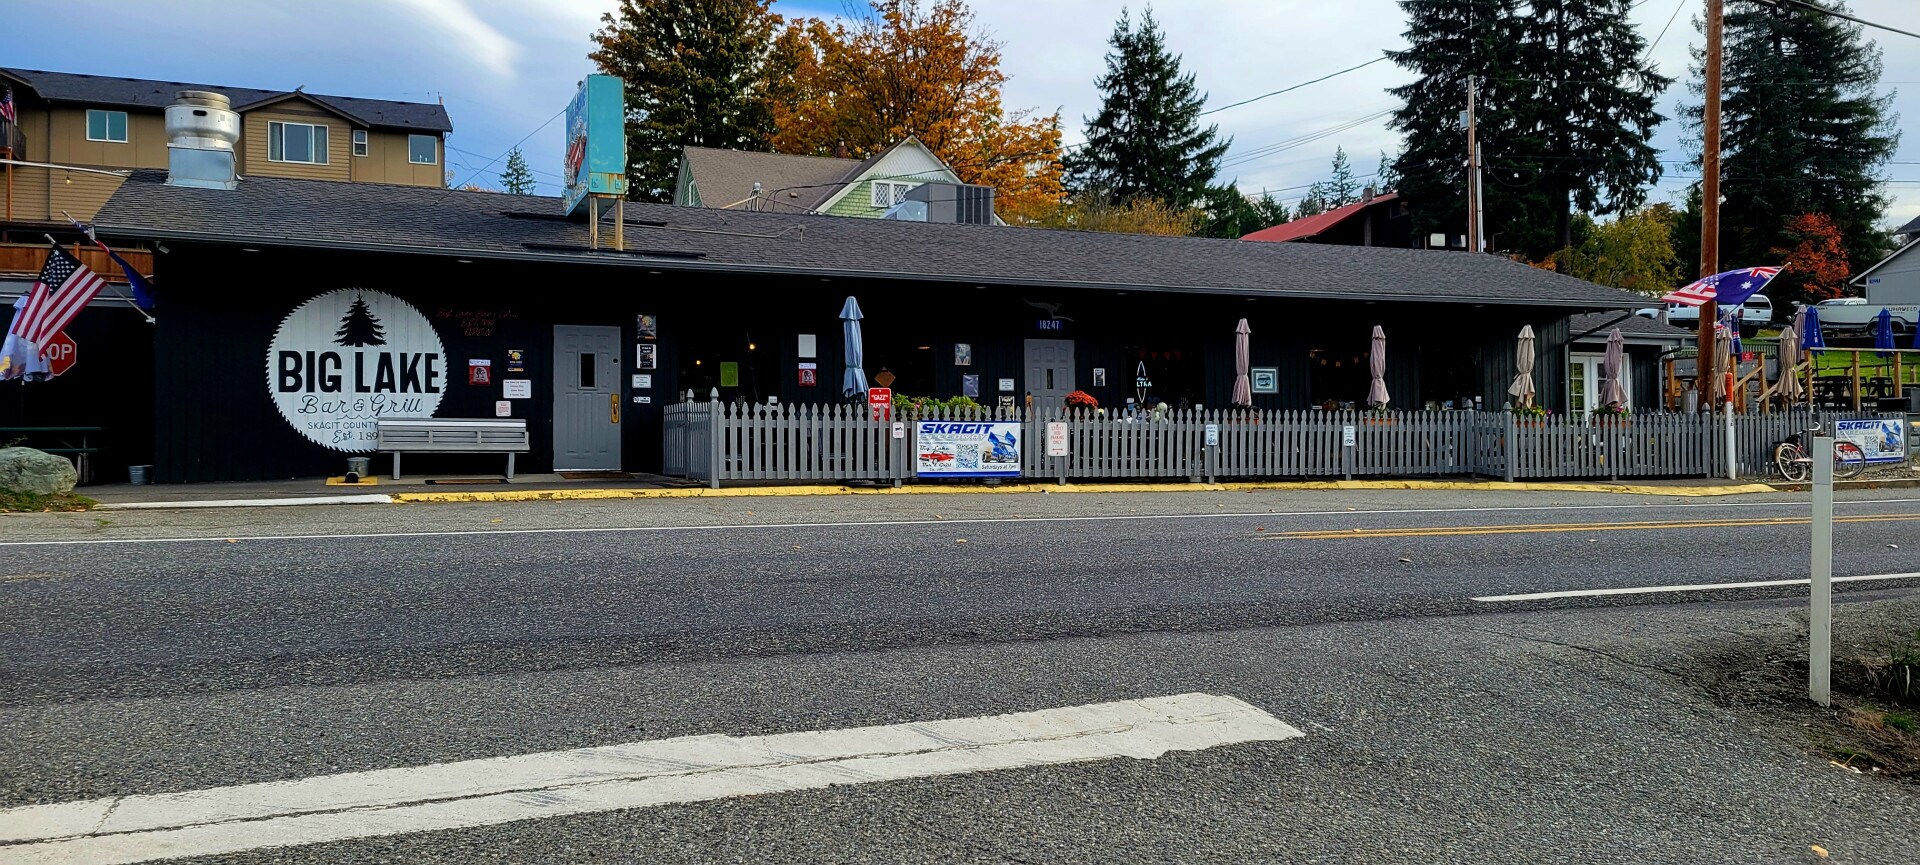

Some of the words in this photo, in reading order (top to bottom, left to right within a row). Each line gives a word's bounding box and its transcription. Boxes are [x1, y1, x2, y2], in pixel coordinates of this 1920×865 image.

[1039, 319, 1060, 330] 18247
[464, 327, 495, 337] OPEN
[46, 343, 73, 360] OP
[278, 350, 342, 393] BIG
[354, 351, 440, 394] LAKE
[297, 394, 350, 414] Bar
[353, 398, 365, 412] &
[370, 393, 423, 416] Grill
[307, 421, 340, 430] SKAGIT
[342, 421, 378, 430] COUNTY
[919, 423, 995, 435] SKAGIT
[1837, 421, 1881, 430] SKAGIT
[332, 430, 355, 443] Est.
[358, 431, 378, 441] 189
